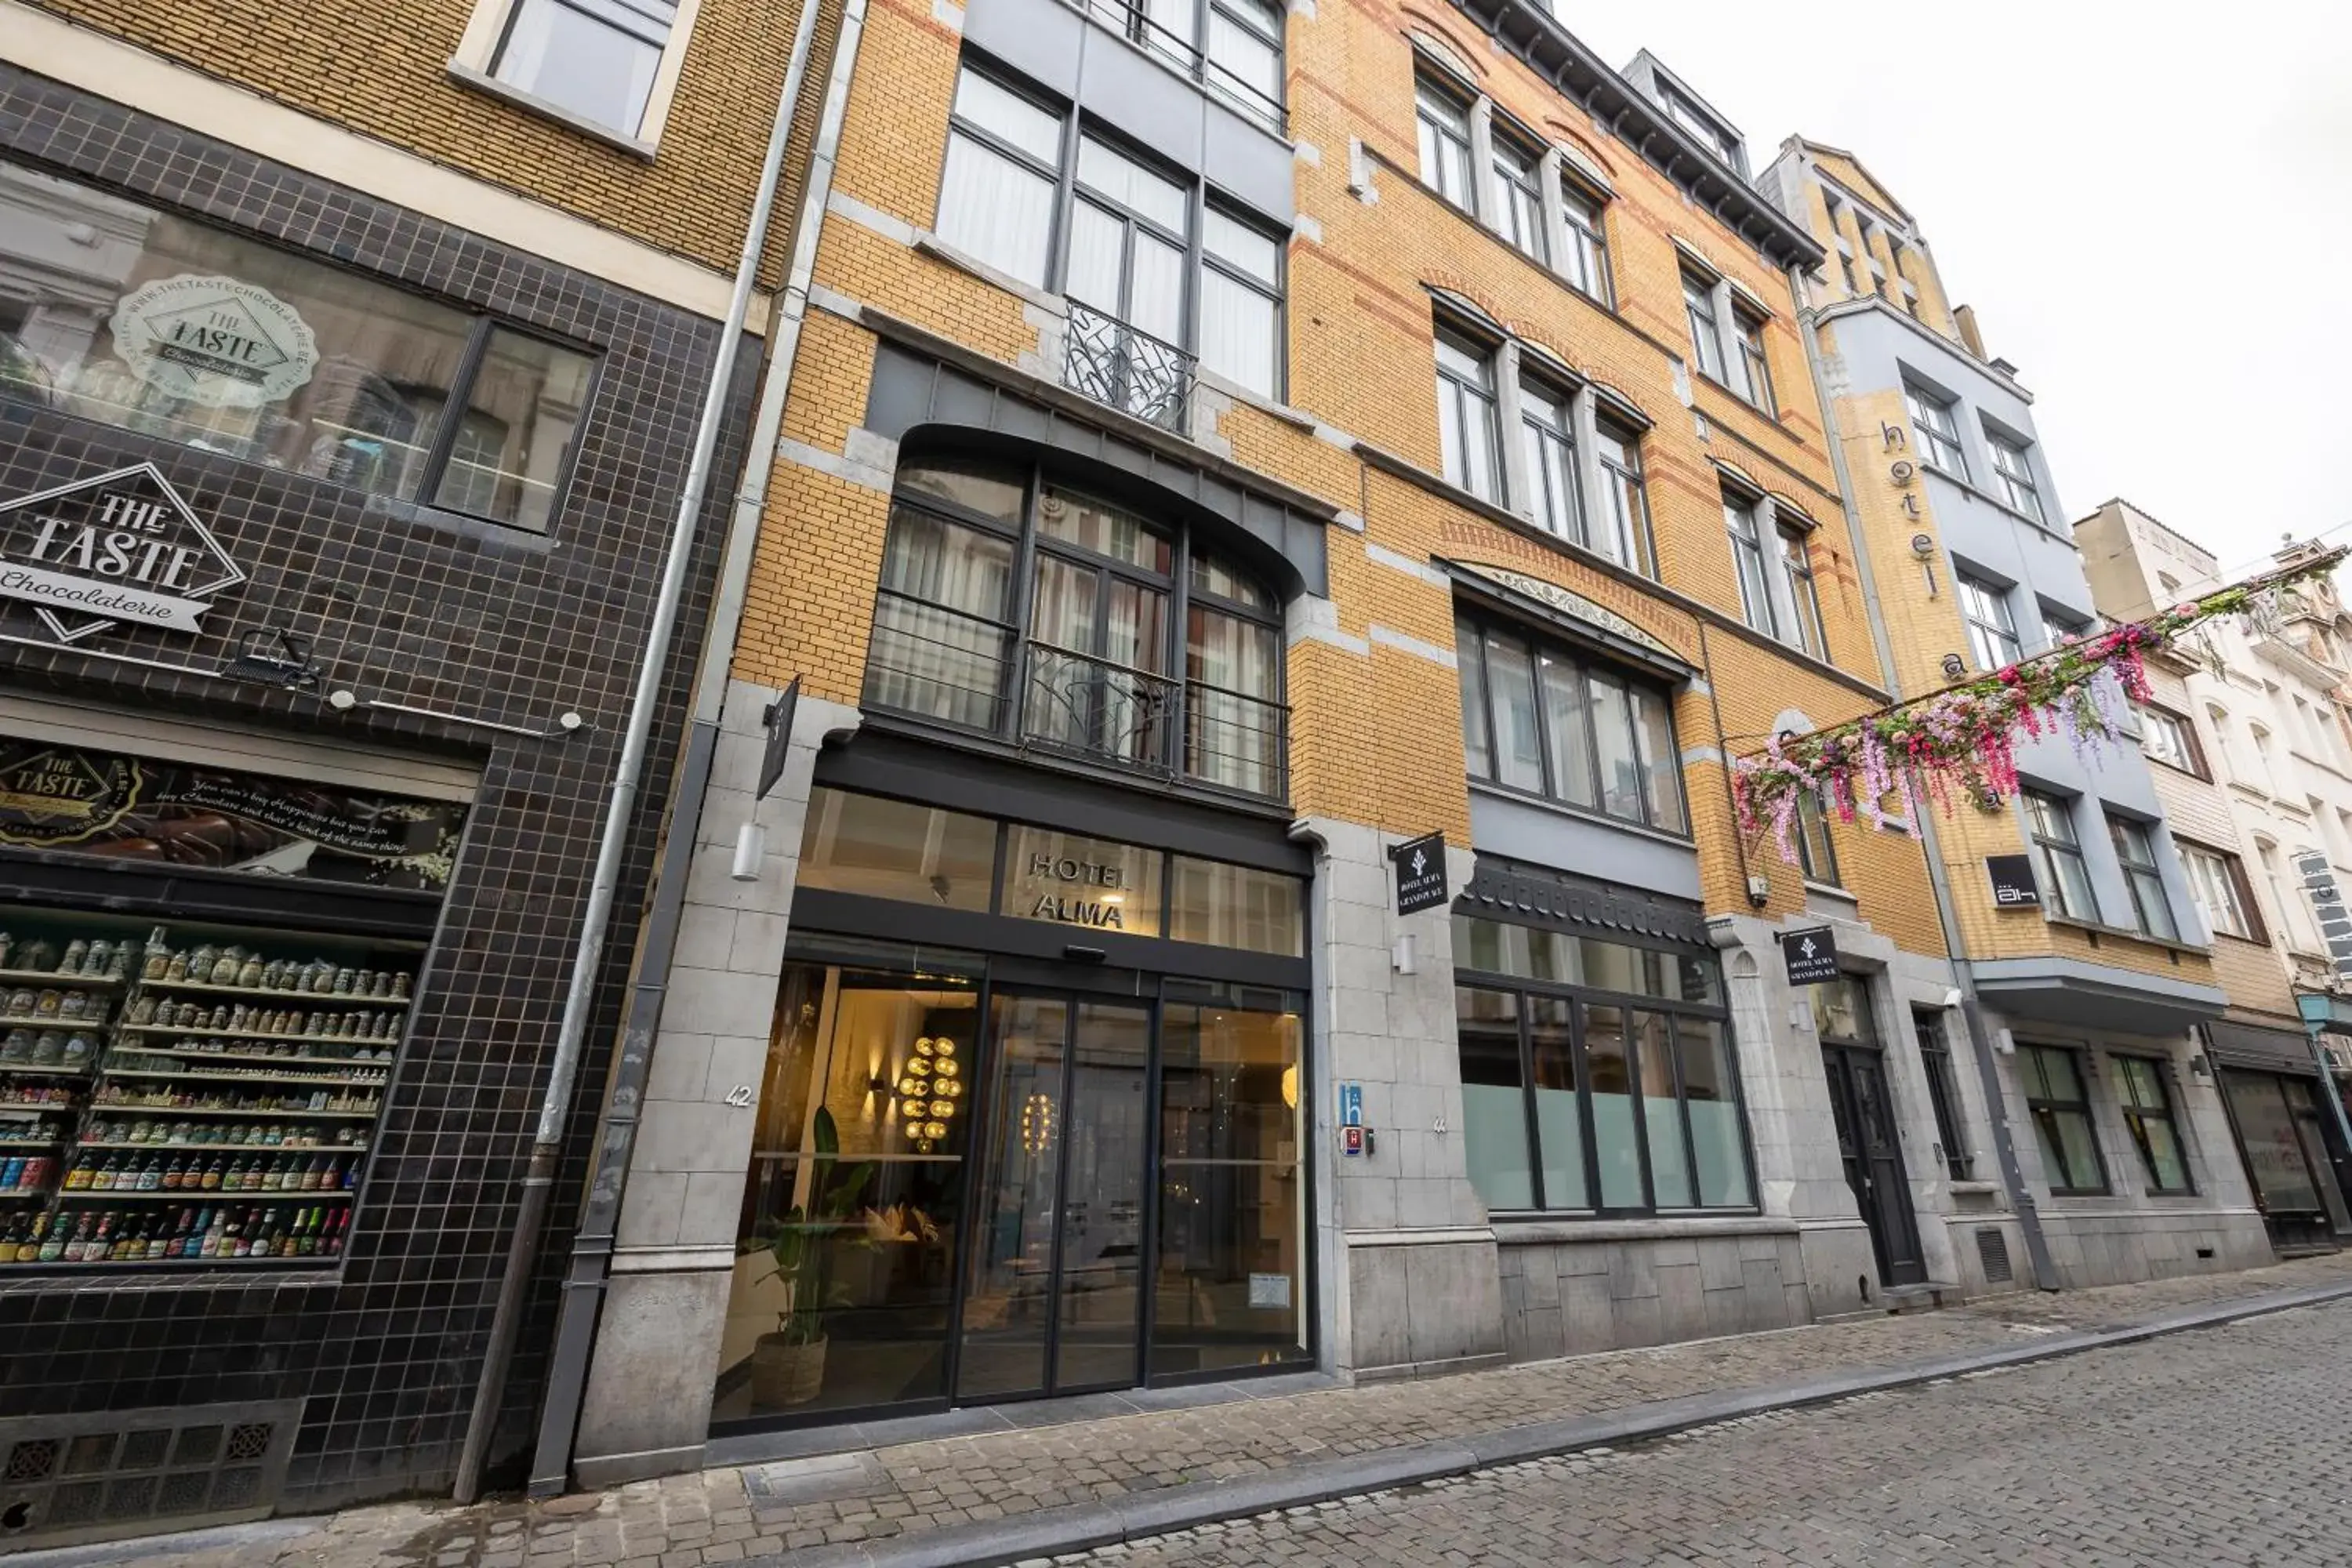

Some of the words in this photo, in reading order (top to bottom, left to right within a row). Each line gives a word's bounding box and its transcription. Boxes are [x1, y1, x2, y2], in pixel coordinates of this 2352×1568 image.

[173, 318, 263, 363] TASTE
[209, 312, 240, 331] THE
[100, 492, 172, 534] THE
[1881, 419, 1938, 601] hotel
[29, 517, 203, 592] TASTE
[0, 570, 175, 619] Chocolaterie
[16, 770, 90, 798] TASTE
[45, 757, 74, 775] THE
[180, 792, 239, 811] Chocolate
[241, 808, 263, 818] and
[333, 833, 350, 845] the
[350, 840, 377, 850] same
[192, 780, 219, 792] You
[250, 793, 270, 807] buy
[270, 797, 328, 823] Happiness
[347, 824, 366, 833] you
[1029, 852, 1131, 890] HOTEL
[1030, 892, 1123, 929] ALMA
[725, 1084, 751, 1106] 42
